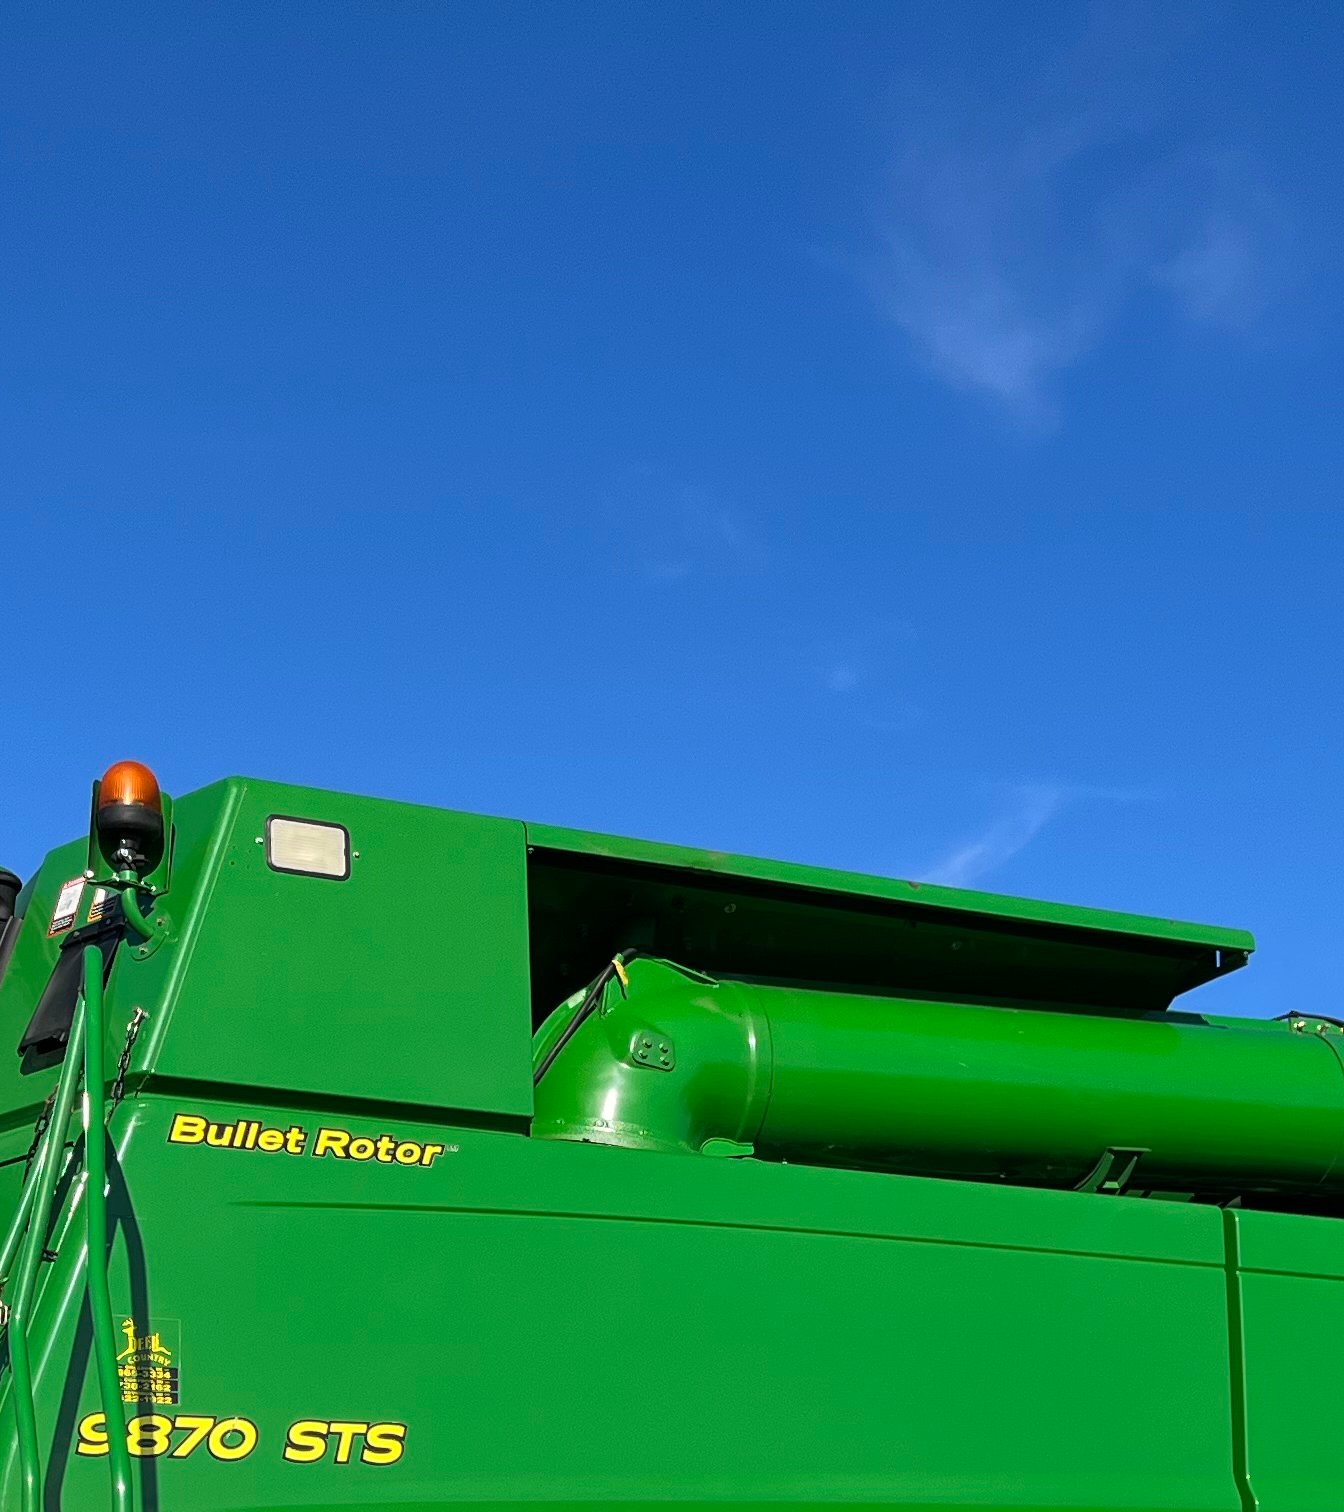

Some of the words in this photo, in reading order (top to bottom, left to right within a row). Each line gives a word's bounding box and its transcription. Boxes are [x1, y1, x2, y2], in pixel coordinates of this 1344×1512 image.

[167, 1113, 308, 1155] Bullet
[312, 1128, 445, 1167] Rotor
[127, 1353, 171, 1366] COUNTRY
[76, 1412, 258, 1462] 9870
[284, 1419, 407, 1466] STS
